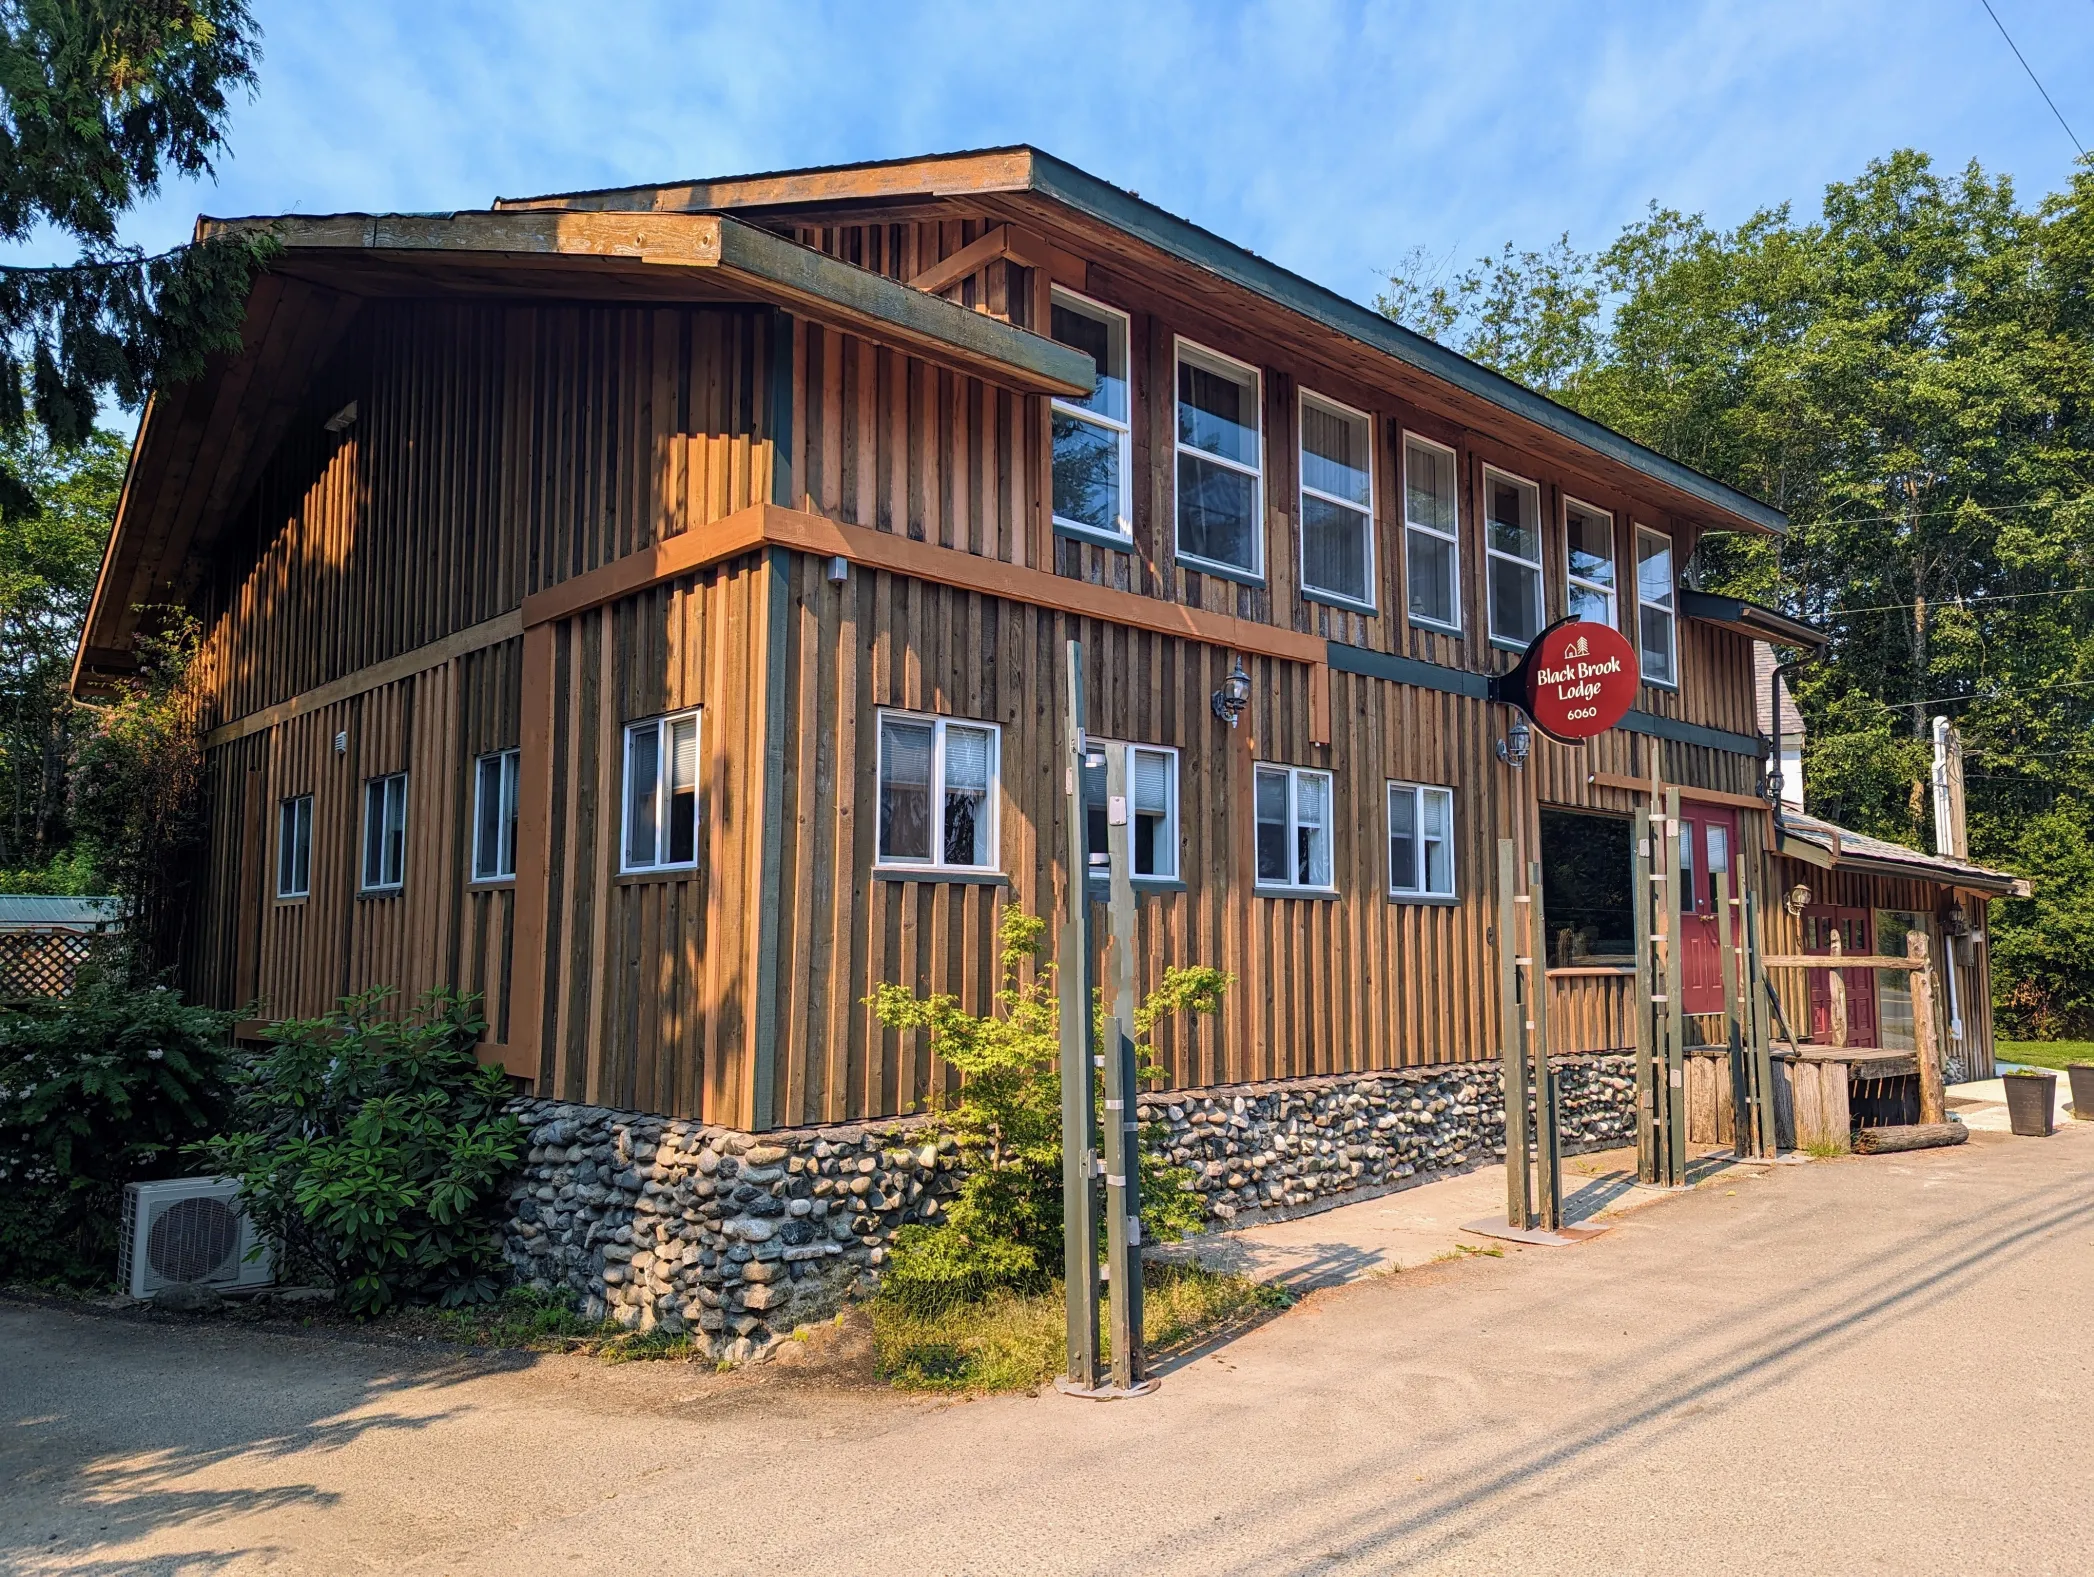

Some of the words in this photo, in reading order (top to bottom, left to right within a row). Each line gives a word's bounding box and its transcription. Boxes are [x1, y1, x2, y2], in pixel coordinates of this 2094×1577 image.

[1537, 664, 1575, 686] Black
[1578, 656, 1621, 679] Brook
[1558, 681, 1601, 700] Lodge
[1567, 707, 1597, 720] 6060
